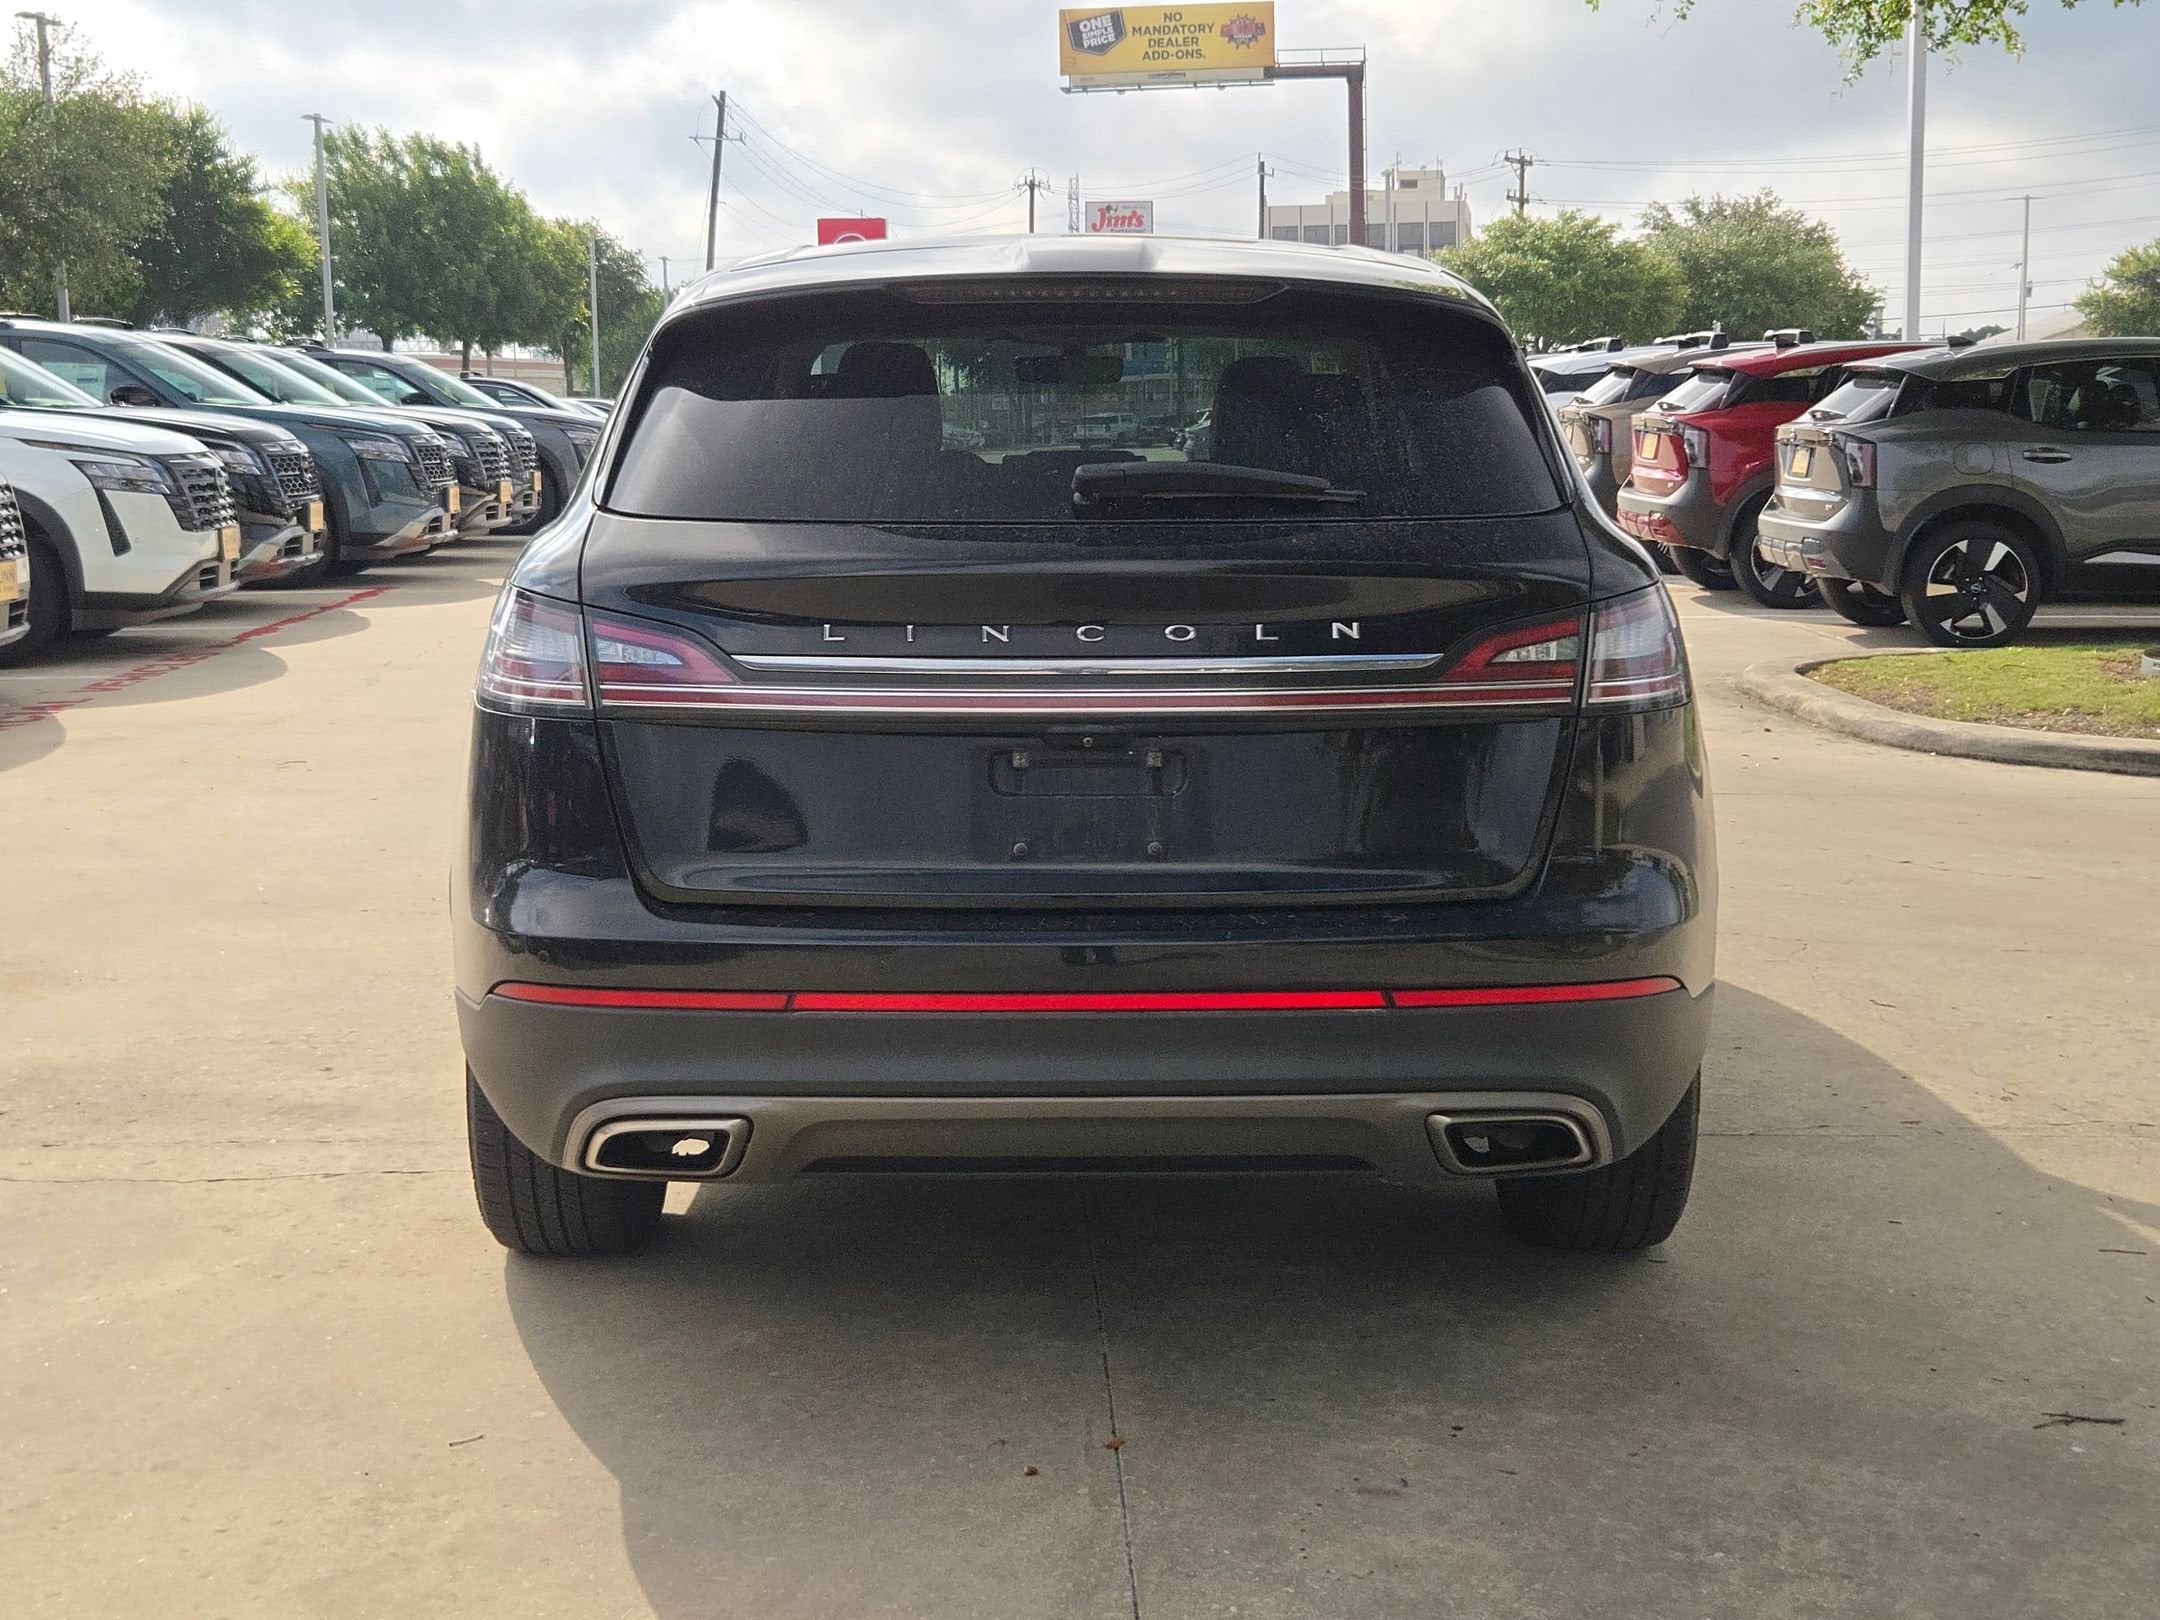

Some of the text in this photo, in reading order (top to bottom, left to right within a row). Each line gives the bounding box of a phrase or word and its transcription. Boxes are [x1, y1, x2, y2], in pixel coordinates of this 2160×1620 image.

[1079, 14, 1113, 32] ONE
[1163, 12, 1183, 23] NO
[1082, 26, 1114, 40] SIMPLE
[1132, 23, 1215, 37] MANDATORY
[1083, 33, 1116, 49] PRICE
[1148, 36, 1200, 48] DEALER
[1142, 49, 1207, 61] ADD-ONS.
[1091, 207, 1145, 233] Jim's
[822, 621, 1361, 643] LINCOLN
